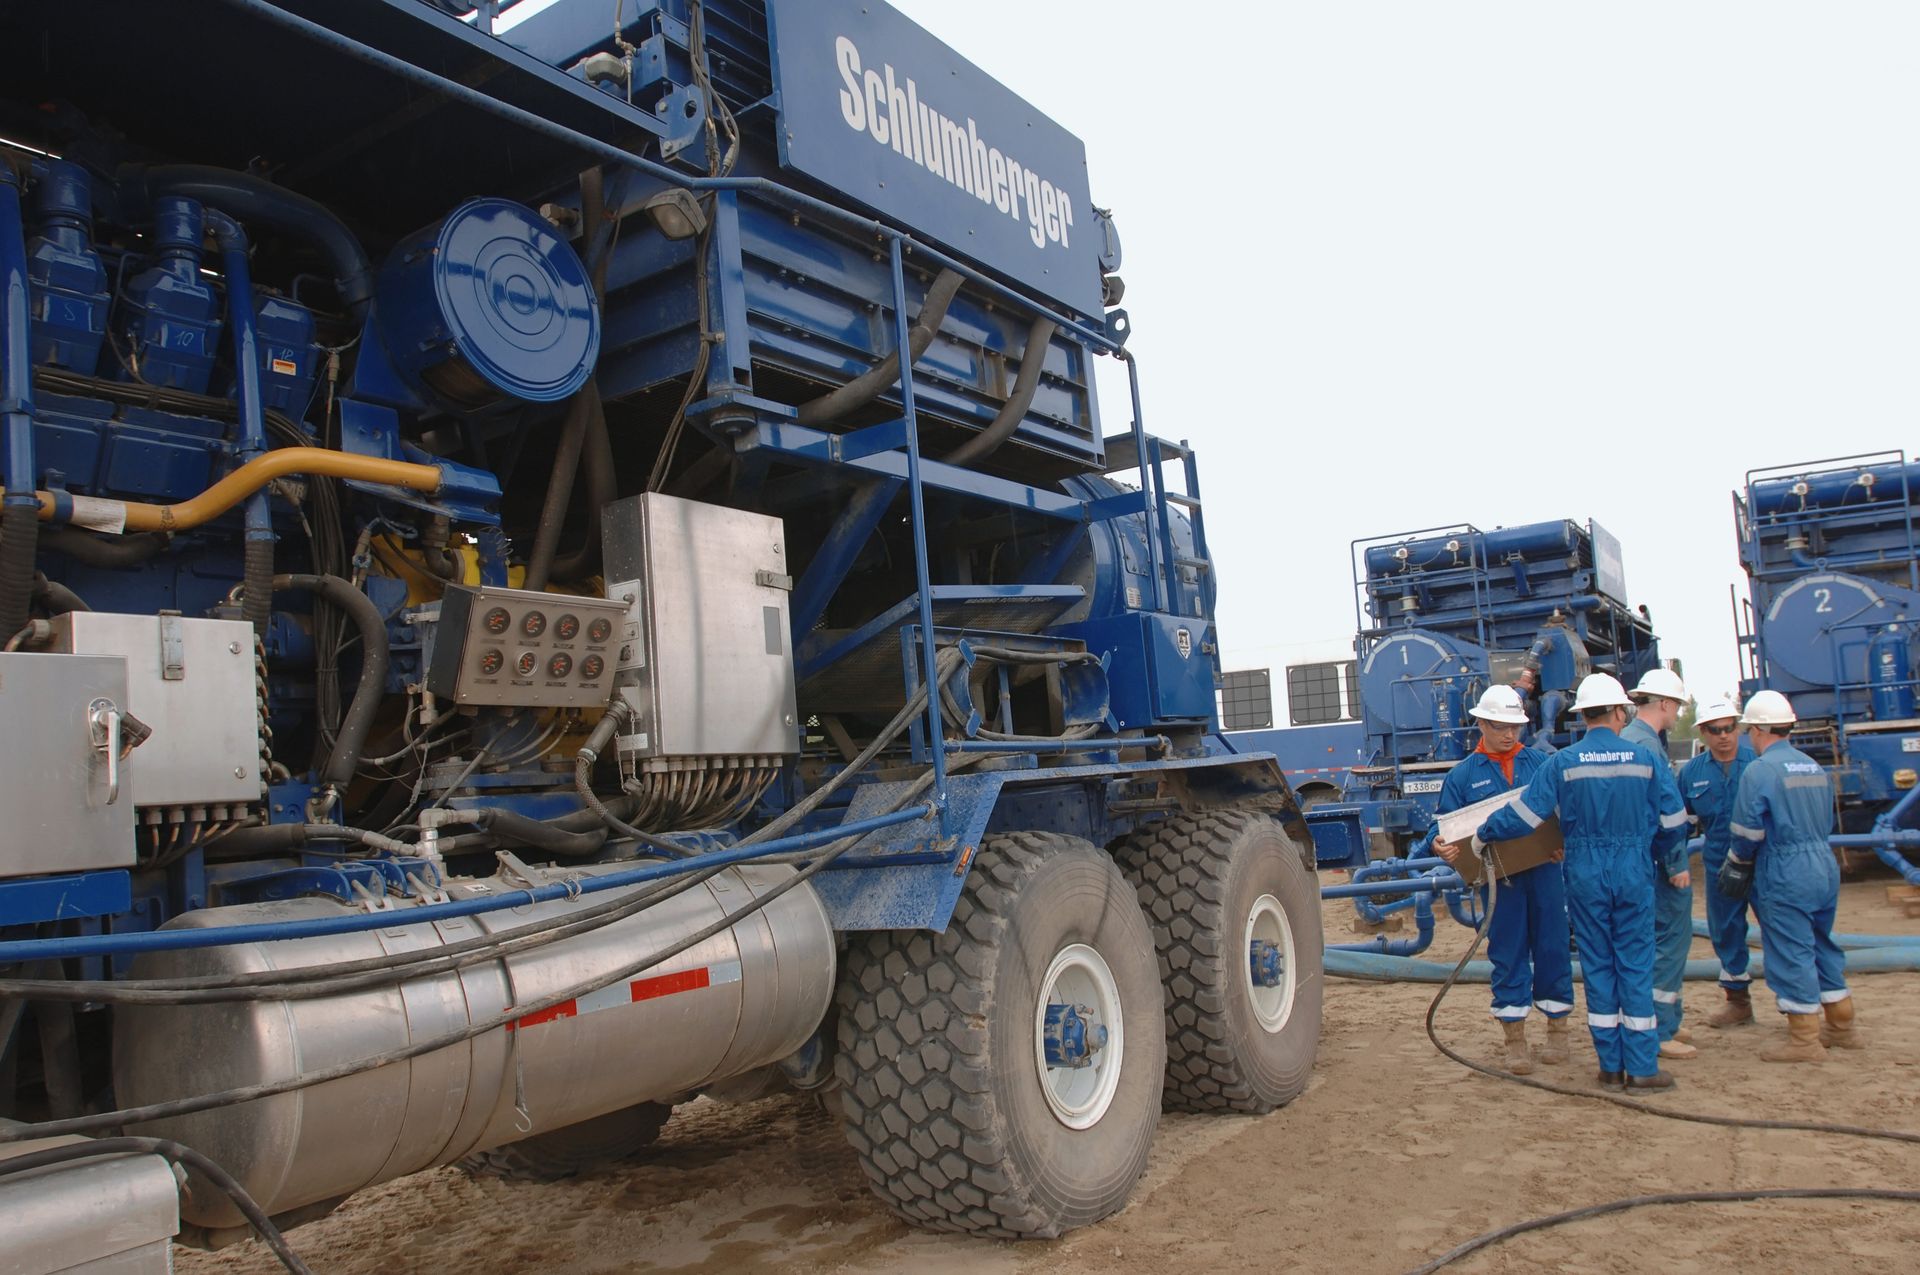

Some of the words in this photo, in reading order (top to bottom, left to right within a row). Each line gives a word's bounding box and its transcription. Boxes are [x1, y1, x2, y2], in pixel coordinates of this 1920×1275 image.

[835, 35, 1073, 249] Schlumberger
[1814, 588, 1832, 612] 2
[1399, 645, 1408, 665] 1
[1579, 751, 1635, 763] Schlumberger
